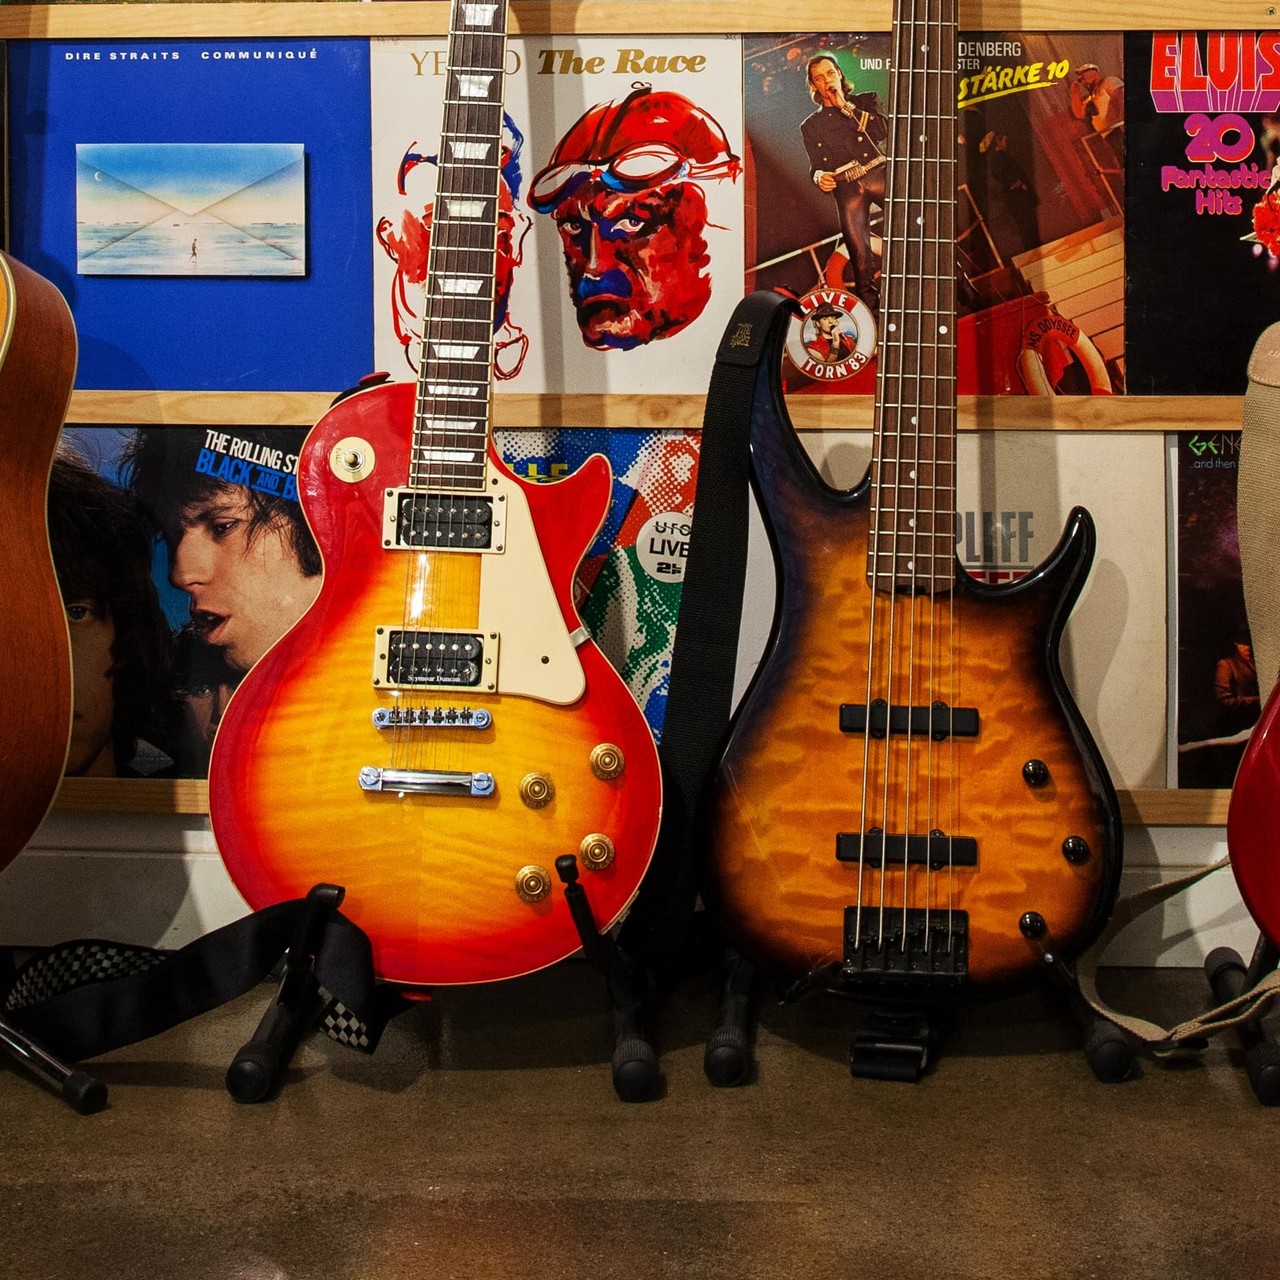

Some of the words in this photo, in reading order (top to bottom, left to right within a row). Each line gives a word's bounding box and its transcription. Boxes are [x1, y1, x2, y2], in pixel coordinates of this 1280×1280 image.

[64, 51, 103, 62] DIRE
[109, 50, 181, 61] STRAITS
[200, 46, 318, 61] COMMUNIQUÉ
[537, 48, 606, 76] The
[612, 48, 707, 75] Race
[860, 58, 882, 70] UND
[1046, 58, 1070, 81] 10
[1184, 113, 1256, 163] 20
[1161, 163, 1272, 192] Fantastic
[1196, 189, 1243, 216] Hits
[799, 291, 848, 315] LIVE
[205, 428, 231, 454] THE
[229, 436, 285, 471] ROLLING
[195, 447, 255, 488] BLACK
[257, 471, 281, 491] AND
[1215, 457, 1236, 469] then
[649, 537, 690, 559] LIVE
[407, 673, 435, 682] Seymour
[437, 674, 461, 682] Duncan
